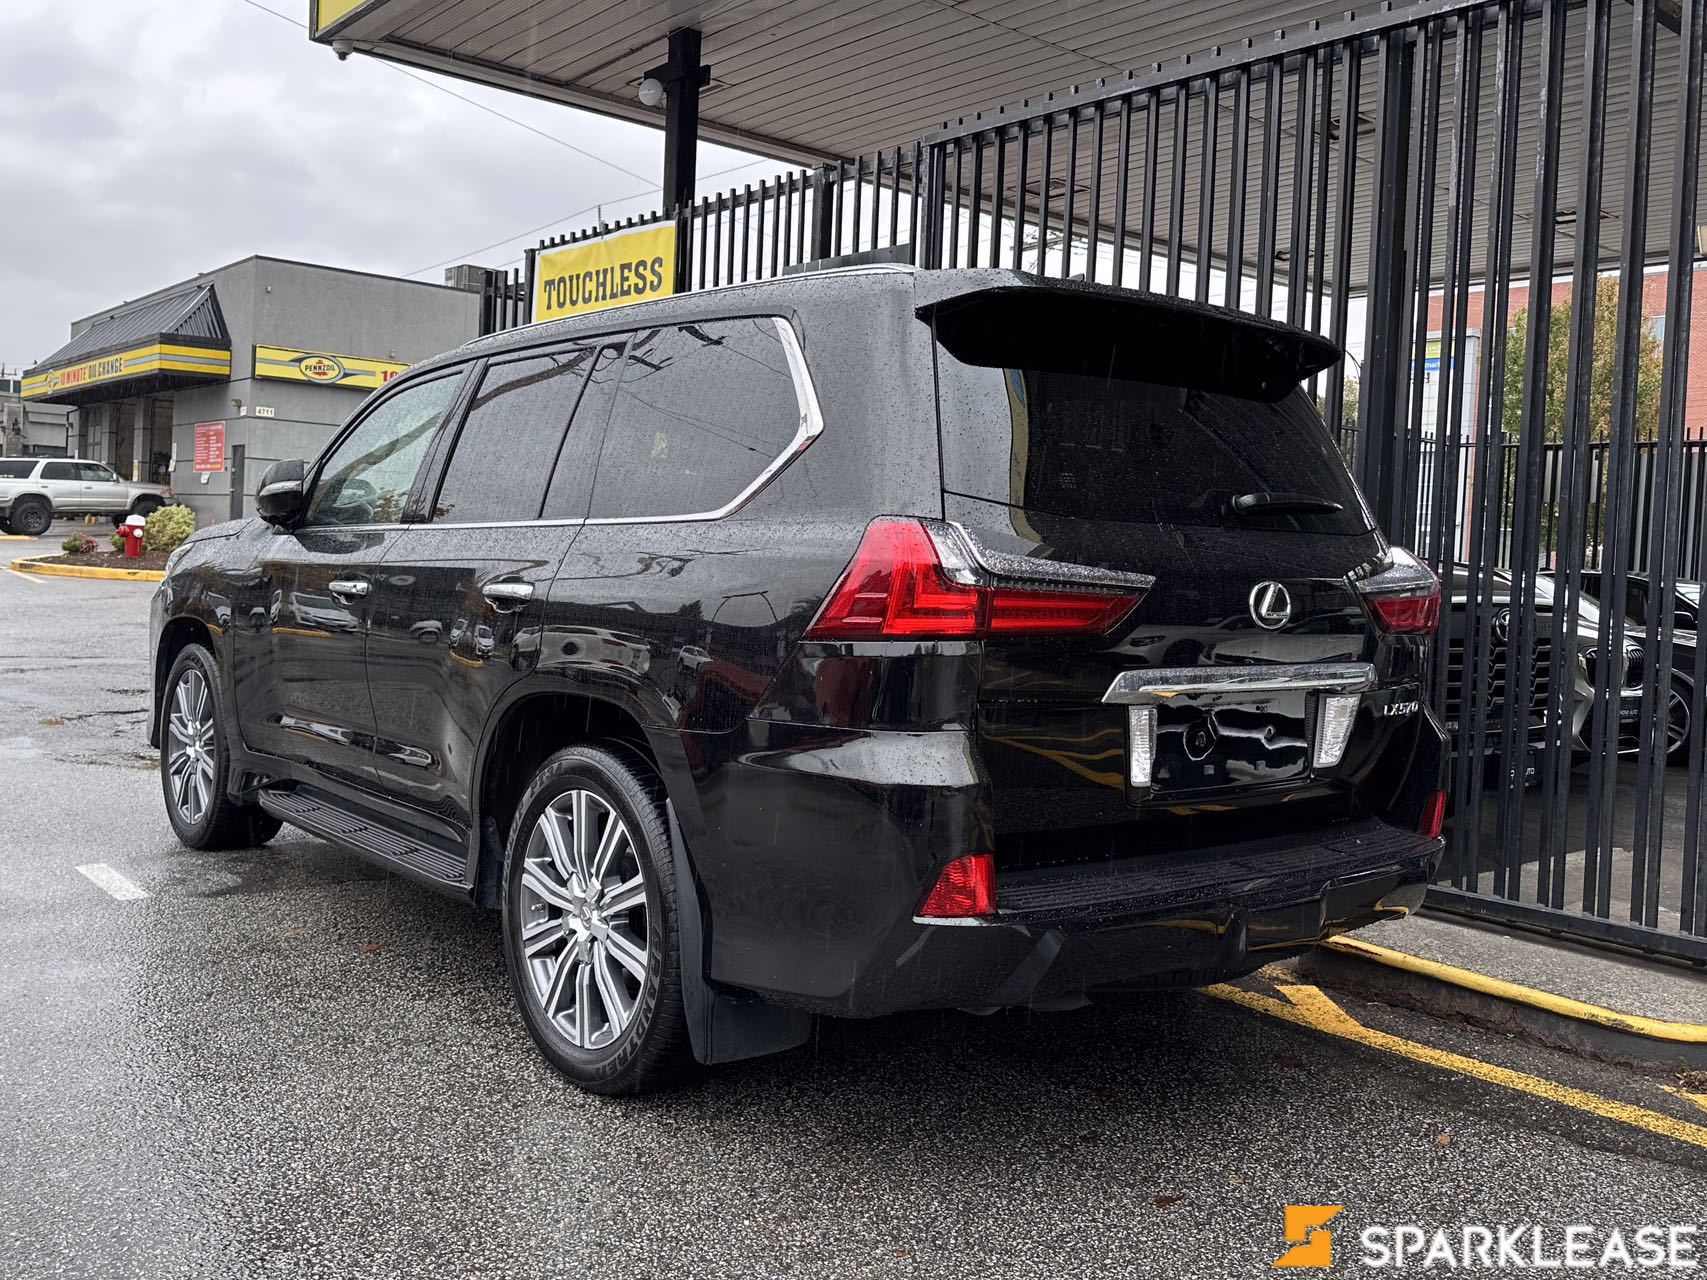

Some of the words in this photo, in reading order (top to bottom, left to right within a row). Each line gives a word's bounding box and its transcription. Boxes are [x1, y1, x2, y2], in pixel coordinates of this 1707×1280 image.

[543, 256, 663, 311] TOUCHLESS
[65, 368, 87, 385] MINUTE
[98, 357, 123, 377] CHANGE
[304, 363, 335, 373] PENNZOIL
